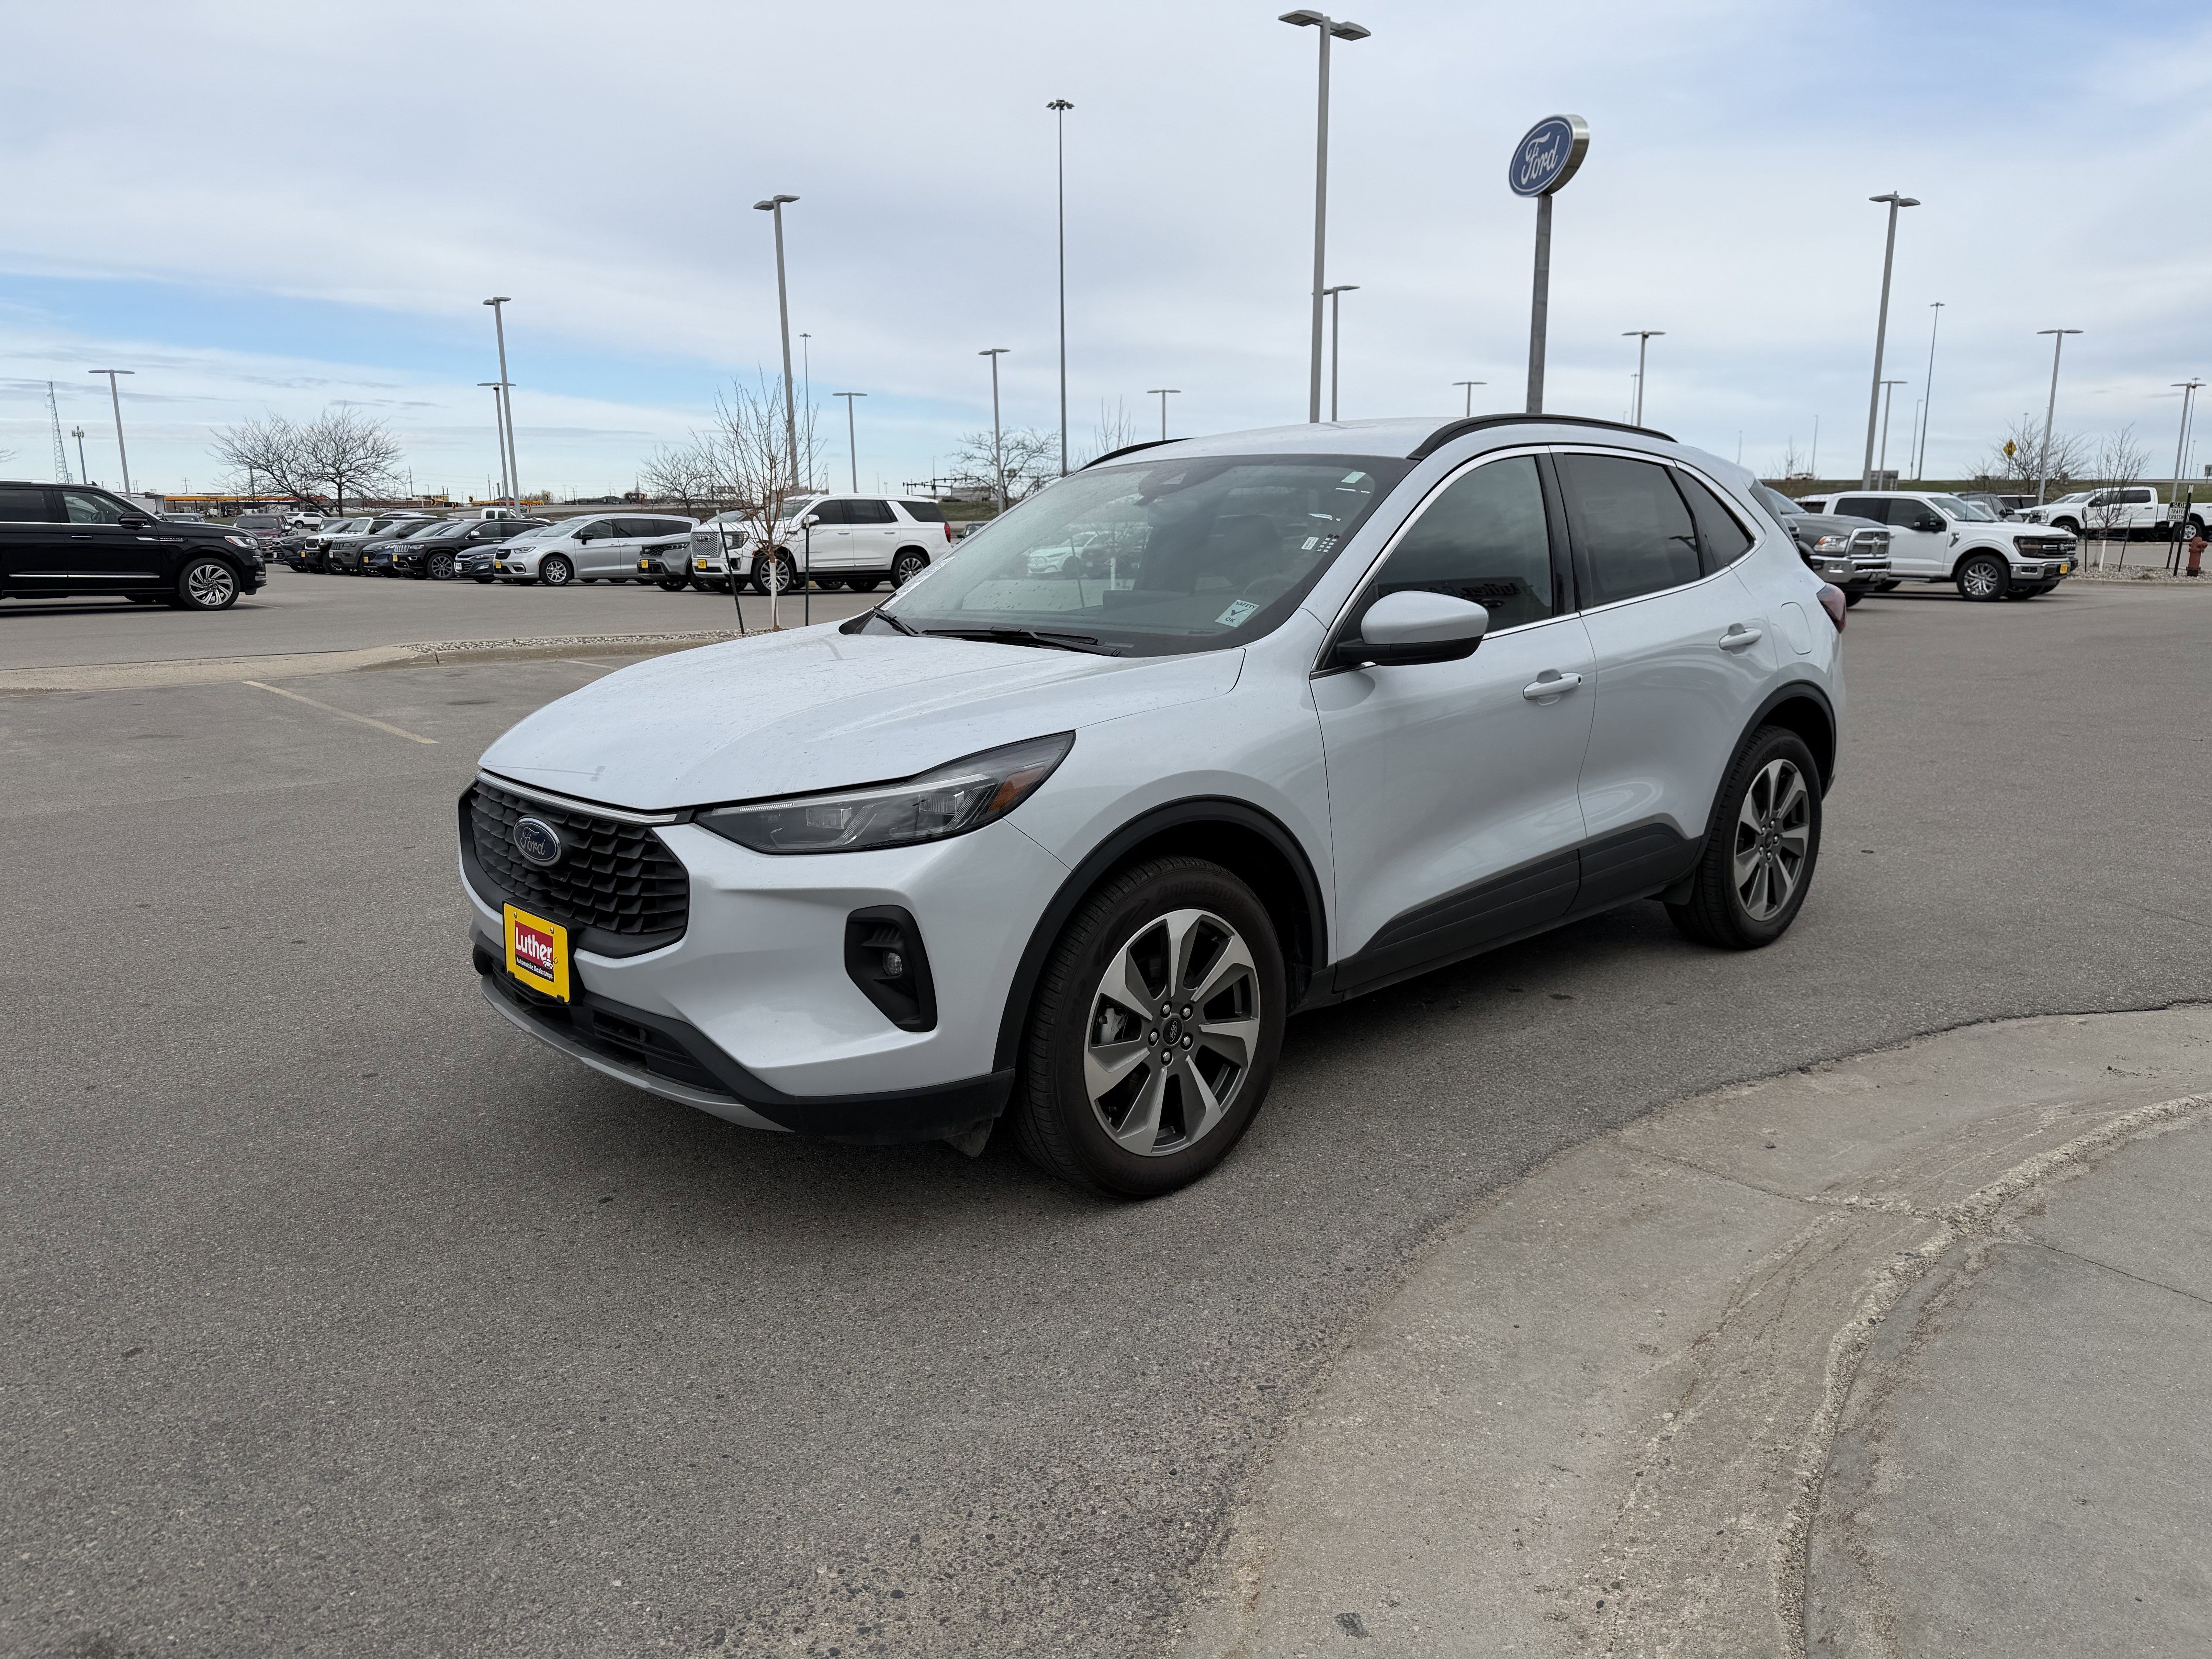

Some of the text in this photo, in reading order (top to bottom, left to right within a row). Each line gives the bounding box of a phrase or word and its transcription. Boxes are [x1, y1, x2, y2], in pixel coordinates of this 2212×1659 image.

[1521, 131, 1560, 185] Ford
[1235, 601, 1257, 609] SAFETY
[520, 826, 545, 855] Ford
[1157, 880, 1249, 910] BRIDGESTONE
[515, 927, 552, 961] Luther
